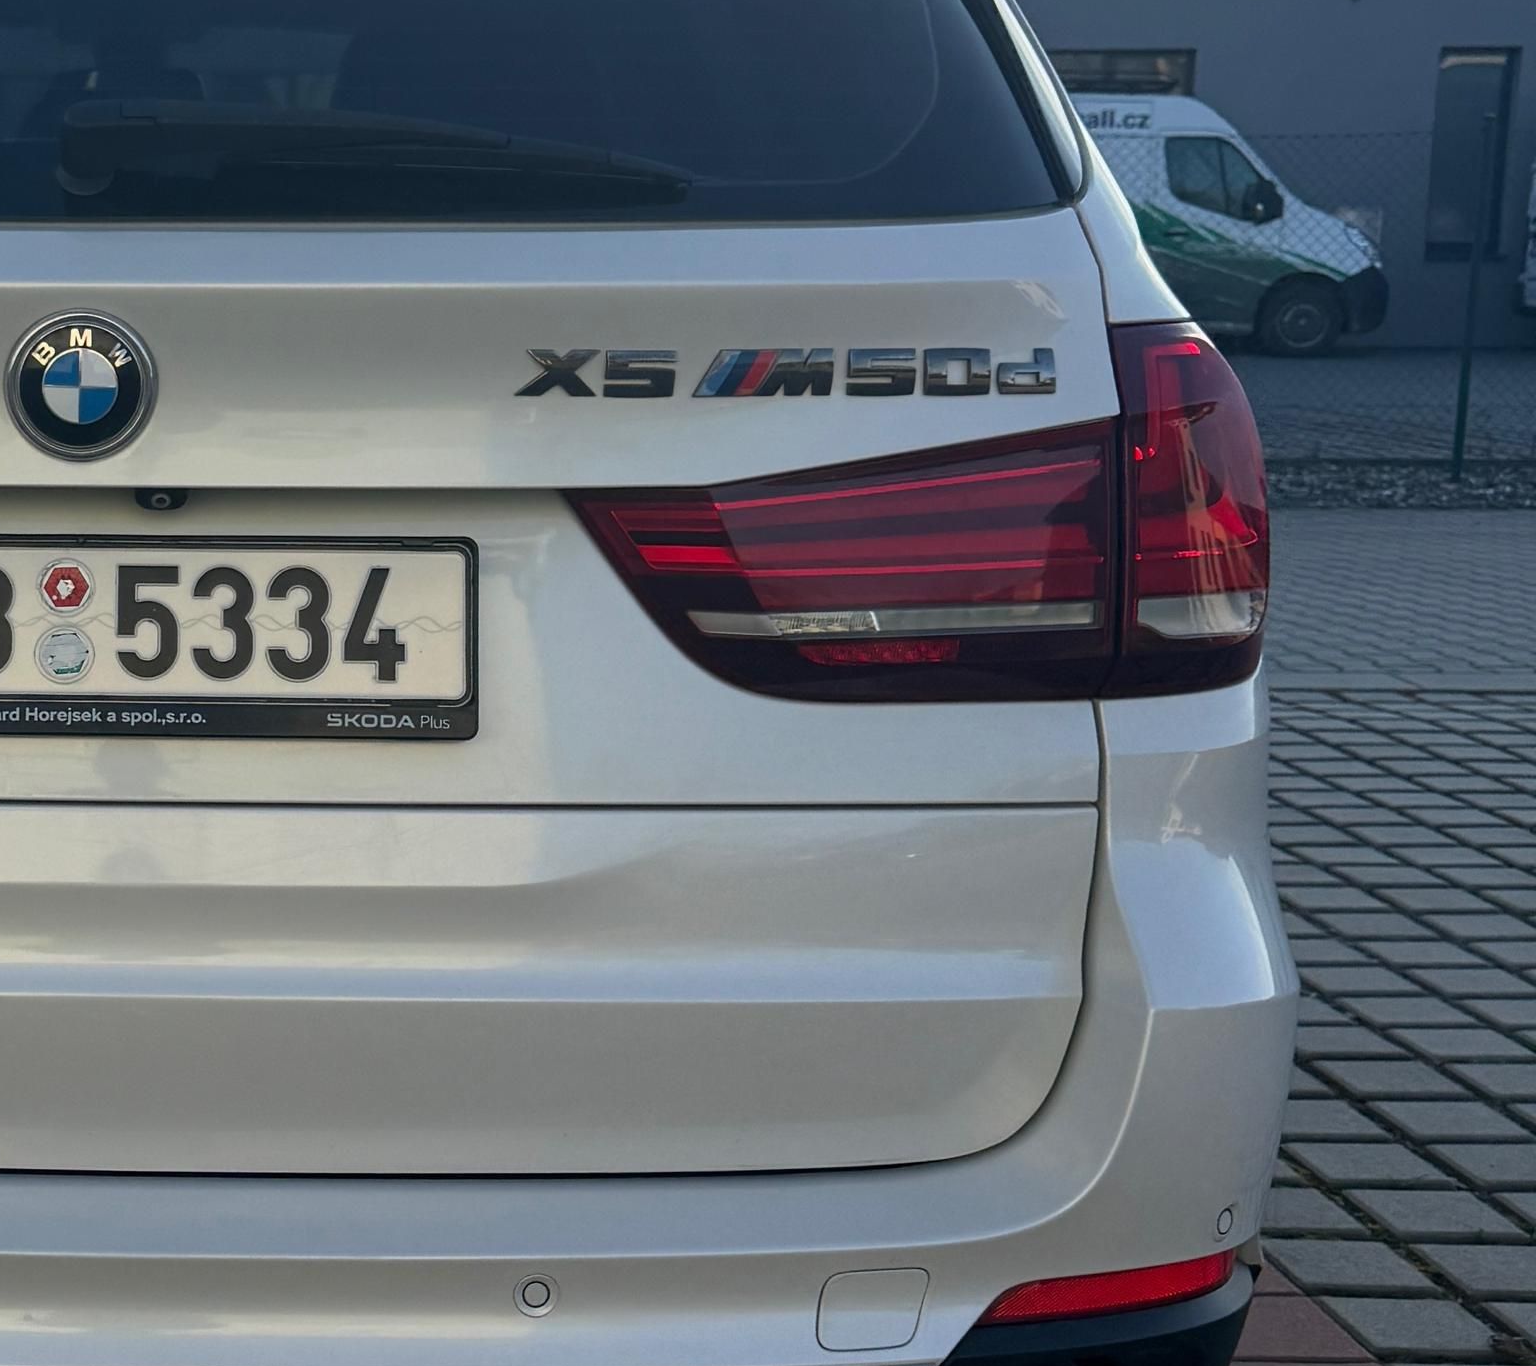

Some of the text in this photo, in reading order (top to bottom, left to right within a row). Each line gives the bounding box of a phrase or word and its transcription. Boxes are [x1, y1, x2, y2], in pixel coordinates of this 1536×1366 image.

[32, 328, 132, 367] BMW
[514, 348, 678, 398] X5
[116, 564, 407, 683] 5334
[25, 706, 102, 725] Horejsek
[106, 711, 117, 723] a
[420, 715, 450, 729] Plus
